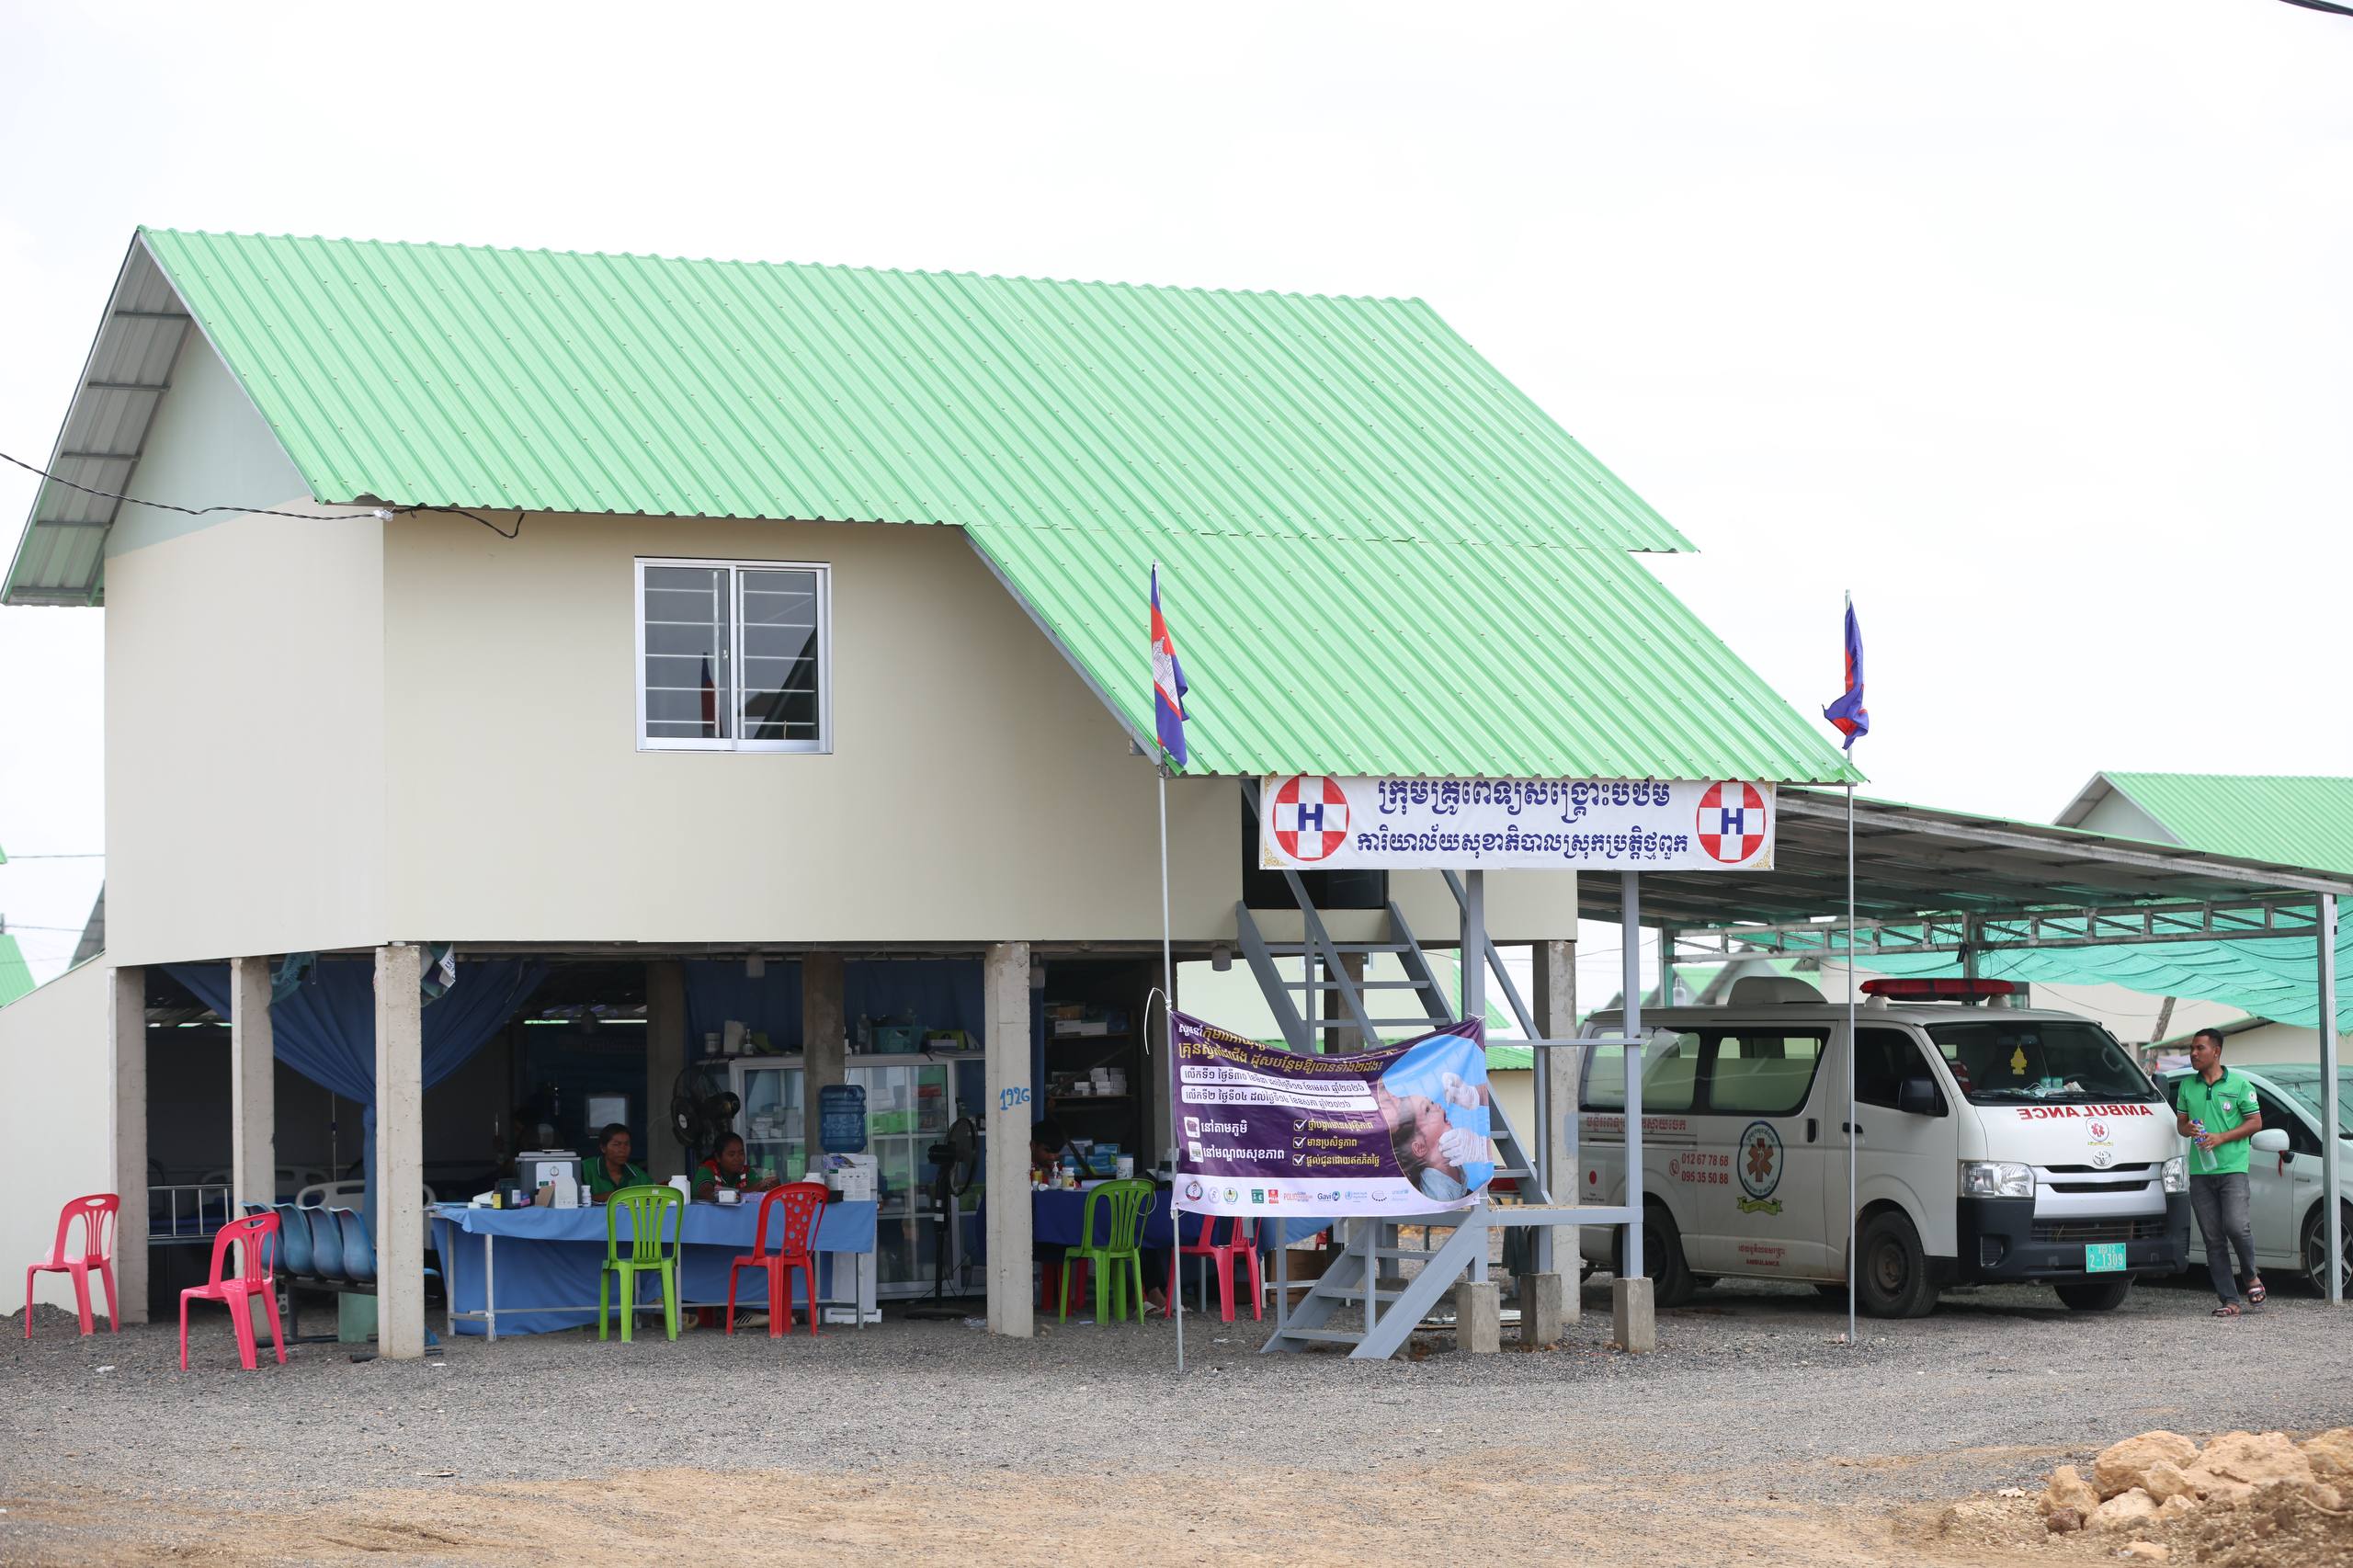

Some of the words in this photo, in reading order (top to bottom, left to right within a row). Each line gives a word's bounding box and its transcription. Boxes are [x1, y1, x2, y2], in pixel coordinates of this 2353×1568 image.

[1298, 802, 1324, 832] H
[1721, 808, 1745, 835] H
[1200, 1119, 1248, 1137] នៅតាមភូមិ
[1681, 1153, 1696, 1165] 012
[1697, 1153, 1707, 1165] 67
[1708, 1154, 1718, 1166] 78
[1681, 1170, 1696, 1182] 095
[1697, 1171, 1707, 1183] 35
[1708, 1172, 1718, 1184] 50
[1719, 1173, 1729, 1185] 88
[1317, 1192, 1332, 1200] Gavi
